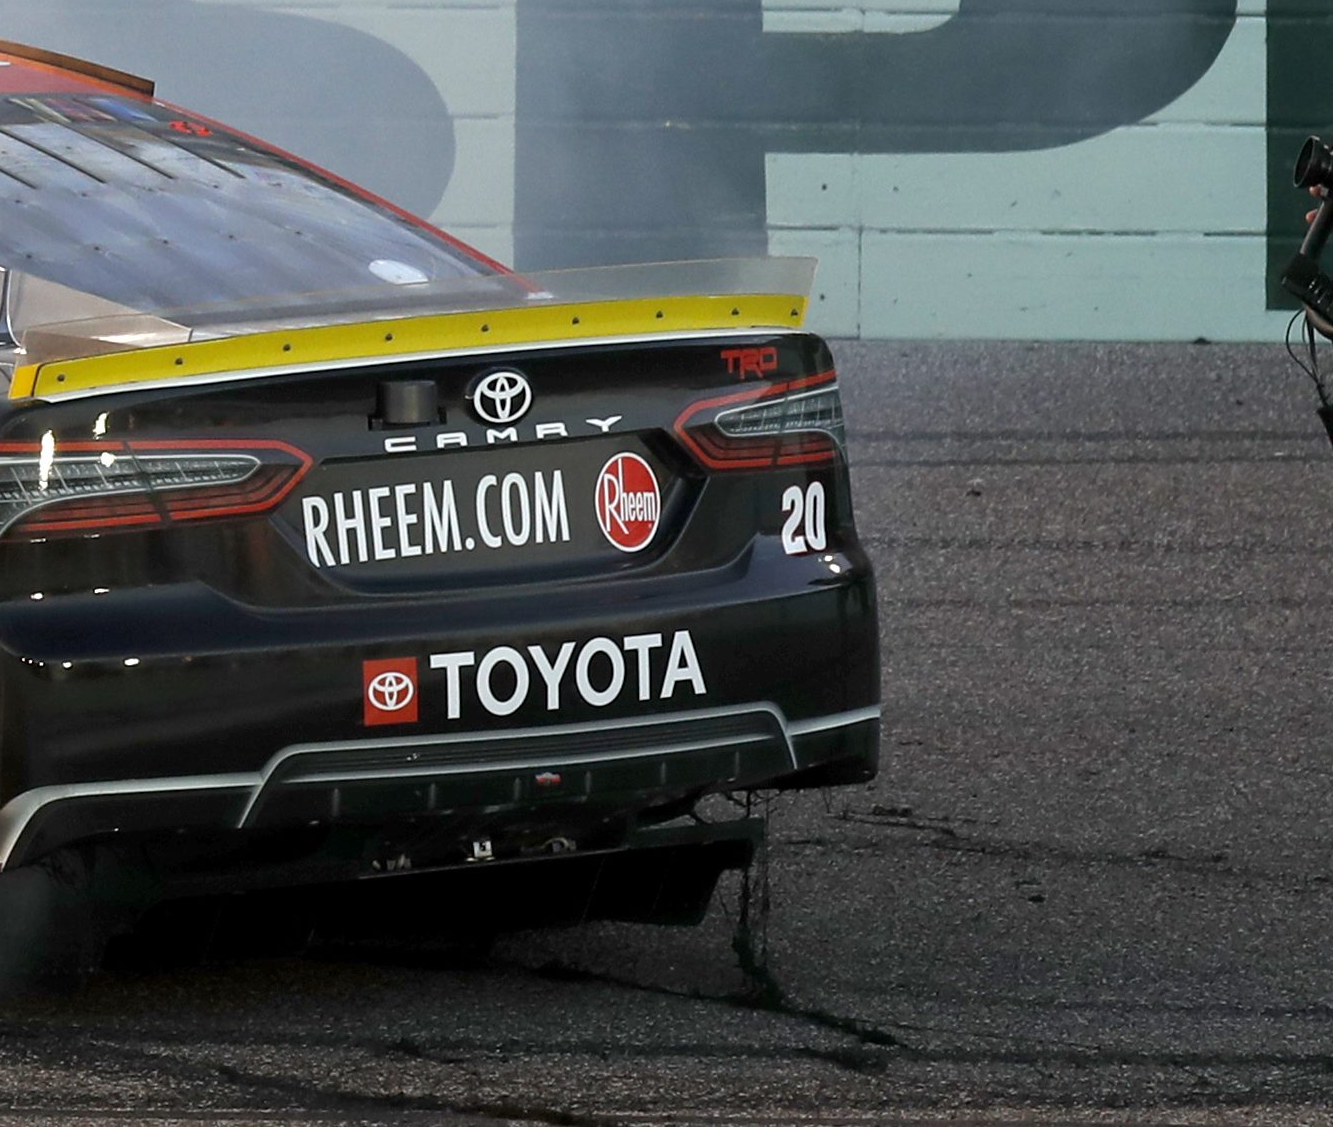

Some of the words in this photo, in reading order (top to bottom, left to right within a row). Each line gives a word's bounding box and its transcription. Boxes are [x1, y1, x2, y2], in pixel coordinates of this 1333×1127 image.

[720, 346, 778, 380] TRD
[383, 415, 623, 453] CAMRY
[300, 469, 571, 570] RHEEM.COM
[602, 460, 659, 536] Rheem
[780, 480, 826, 555] 20
[429, 628, 707, 720] TOYOTA
